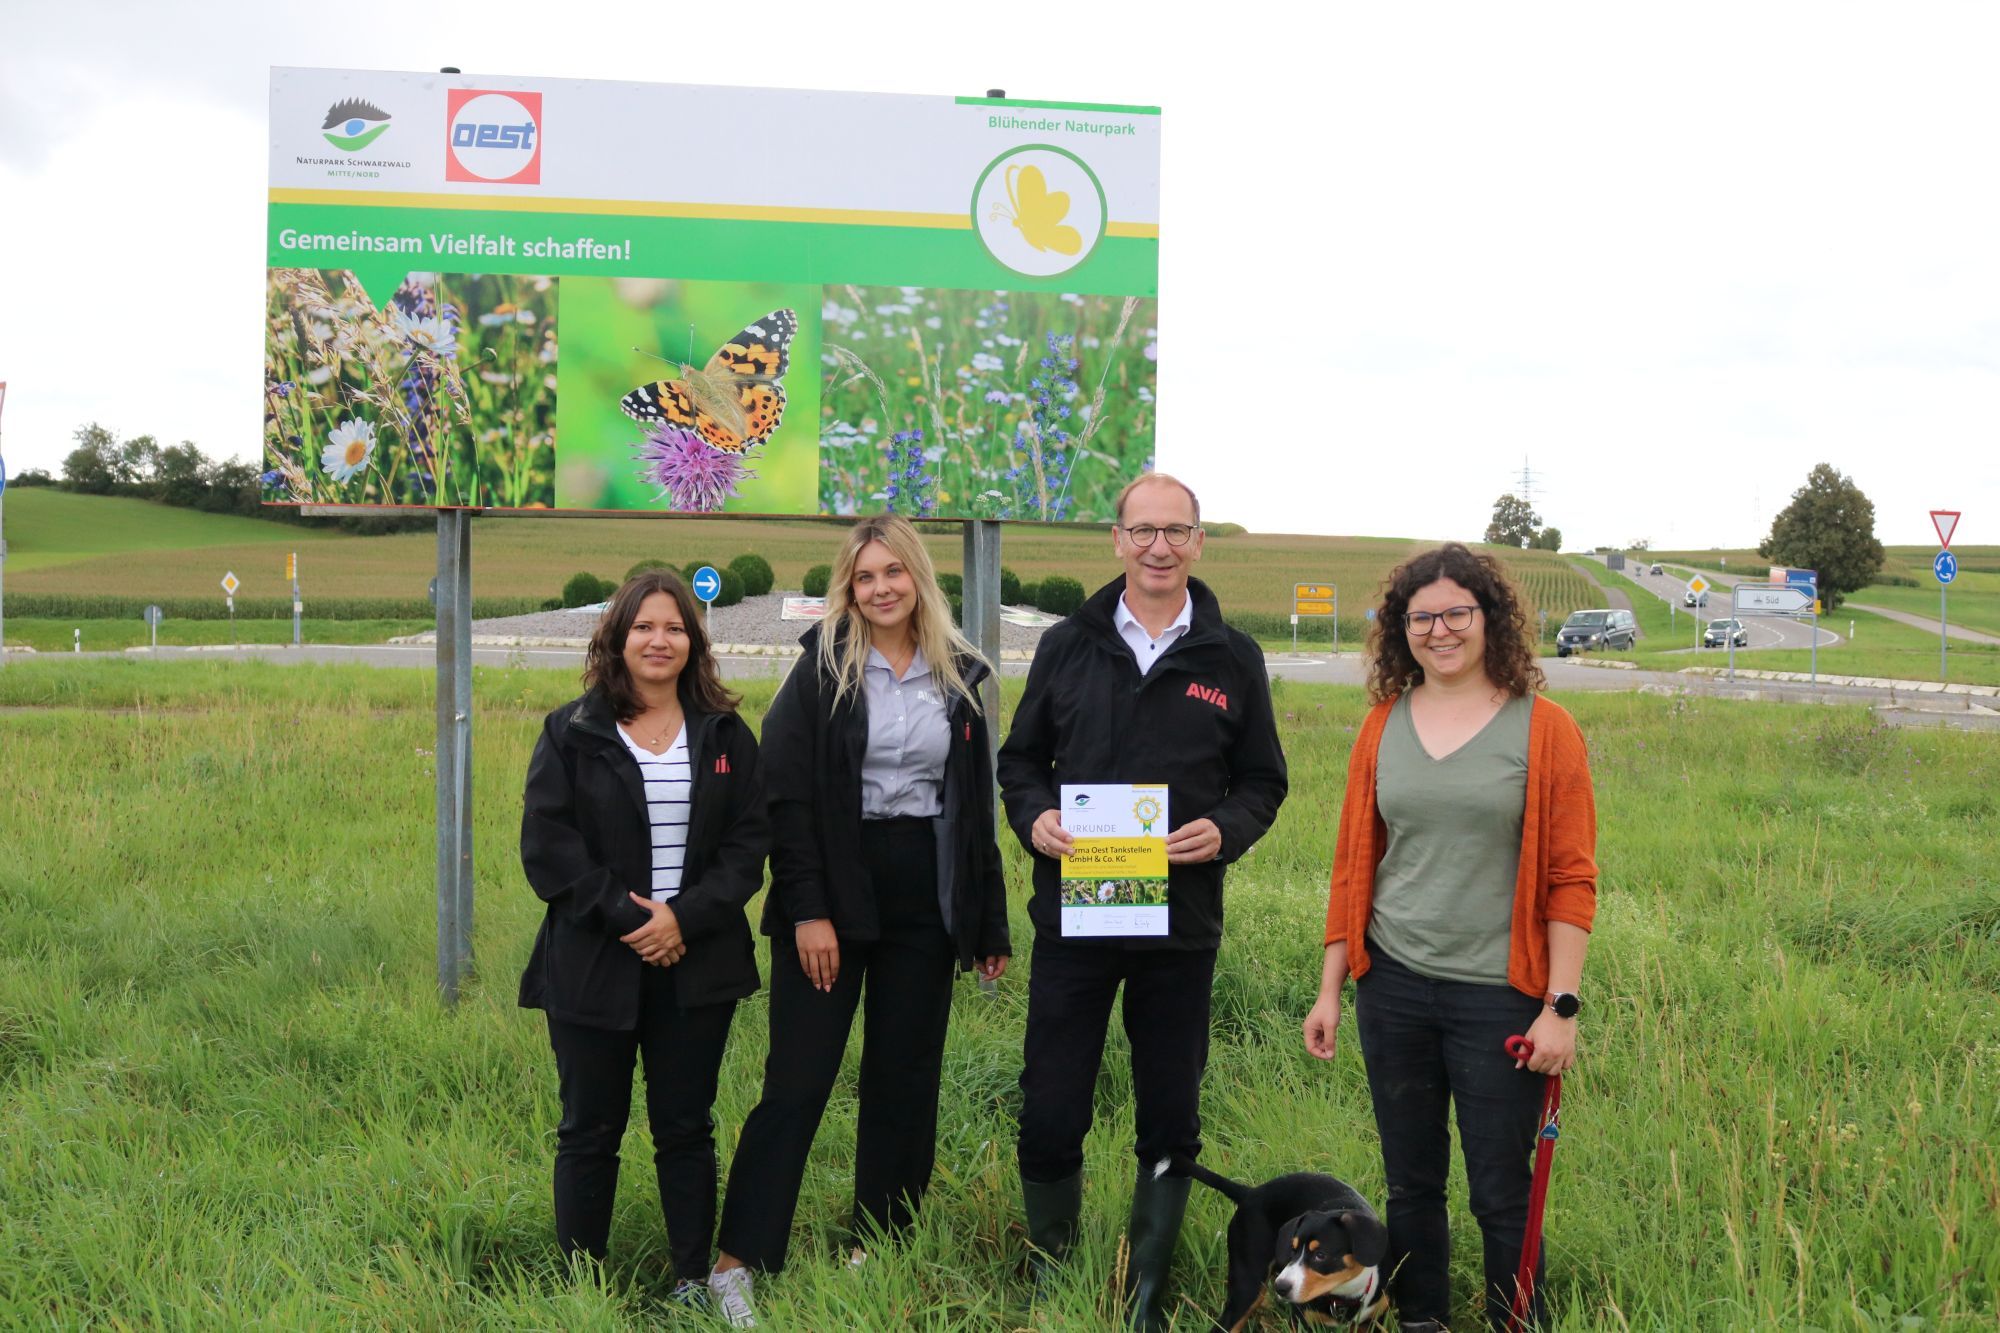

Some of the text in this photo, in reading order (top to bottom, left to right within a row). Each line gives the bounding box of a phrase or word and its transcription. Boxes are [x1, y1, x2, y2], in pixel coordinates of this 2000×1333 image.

[988, 115, 1135, 136] Blühender Naturpark
[452, 121, 535, 150] oest
[278, 228, 631, 260] Gemeinsam Vielfalt schaffen!
[1765, 595, 1780, 604] Süd
[1068, 824, 1117, 833] URKUNDE
[1091, 846, 1108, 854] Oest
[1110, 846, 1152, 854] Tankstellen
[1069, 855, 1127, 863] GmbH & Co. KG
